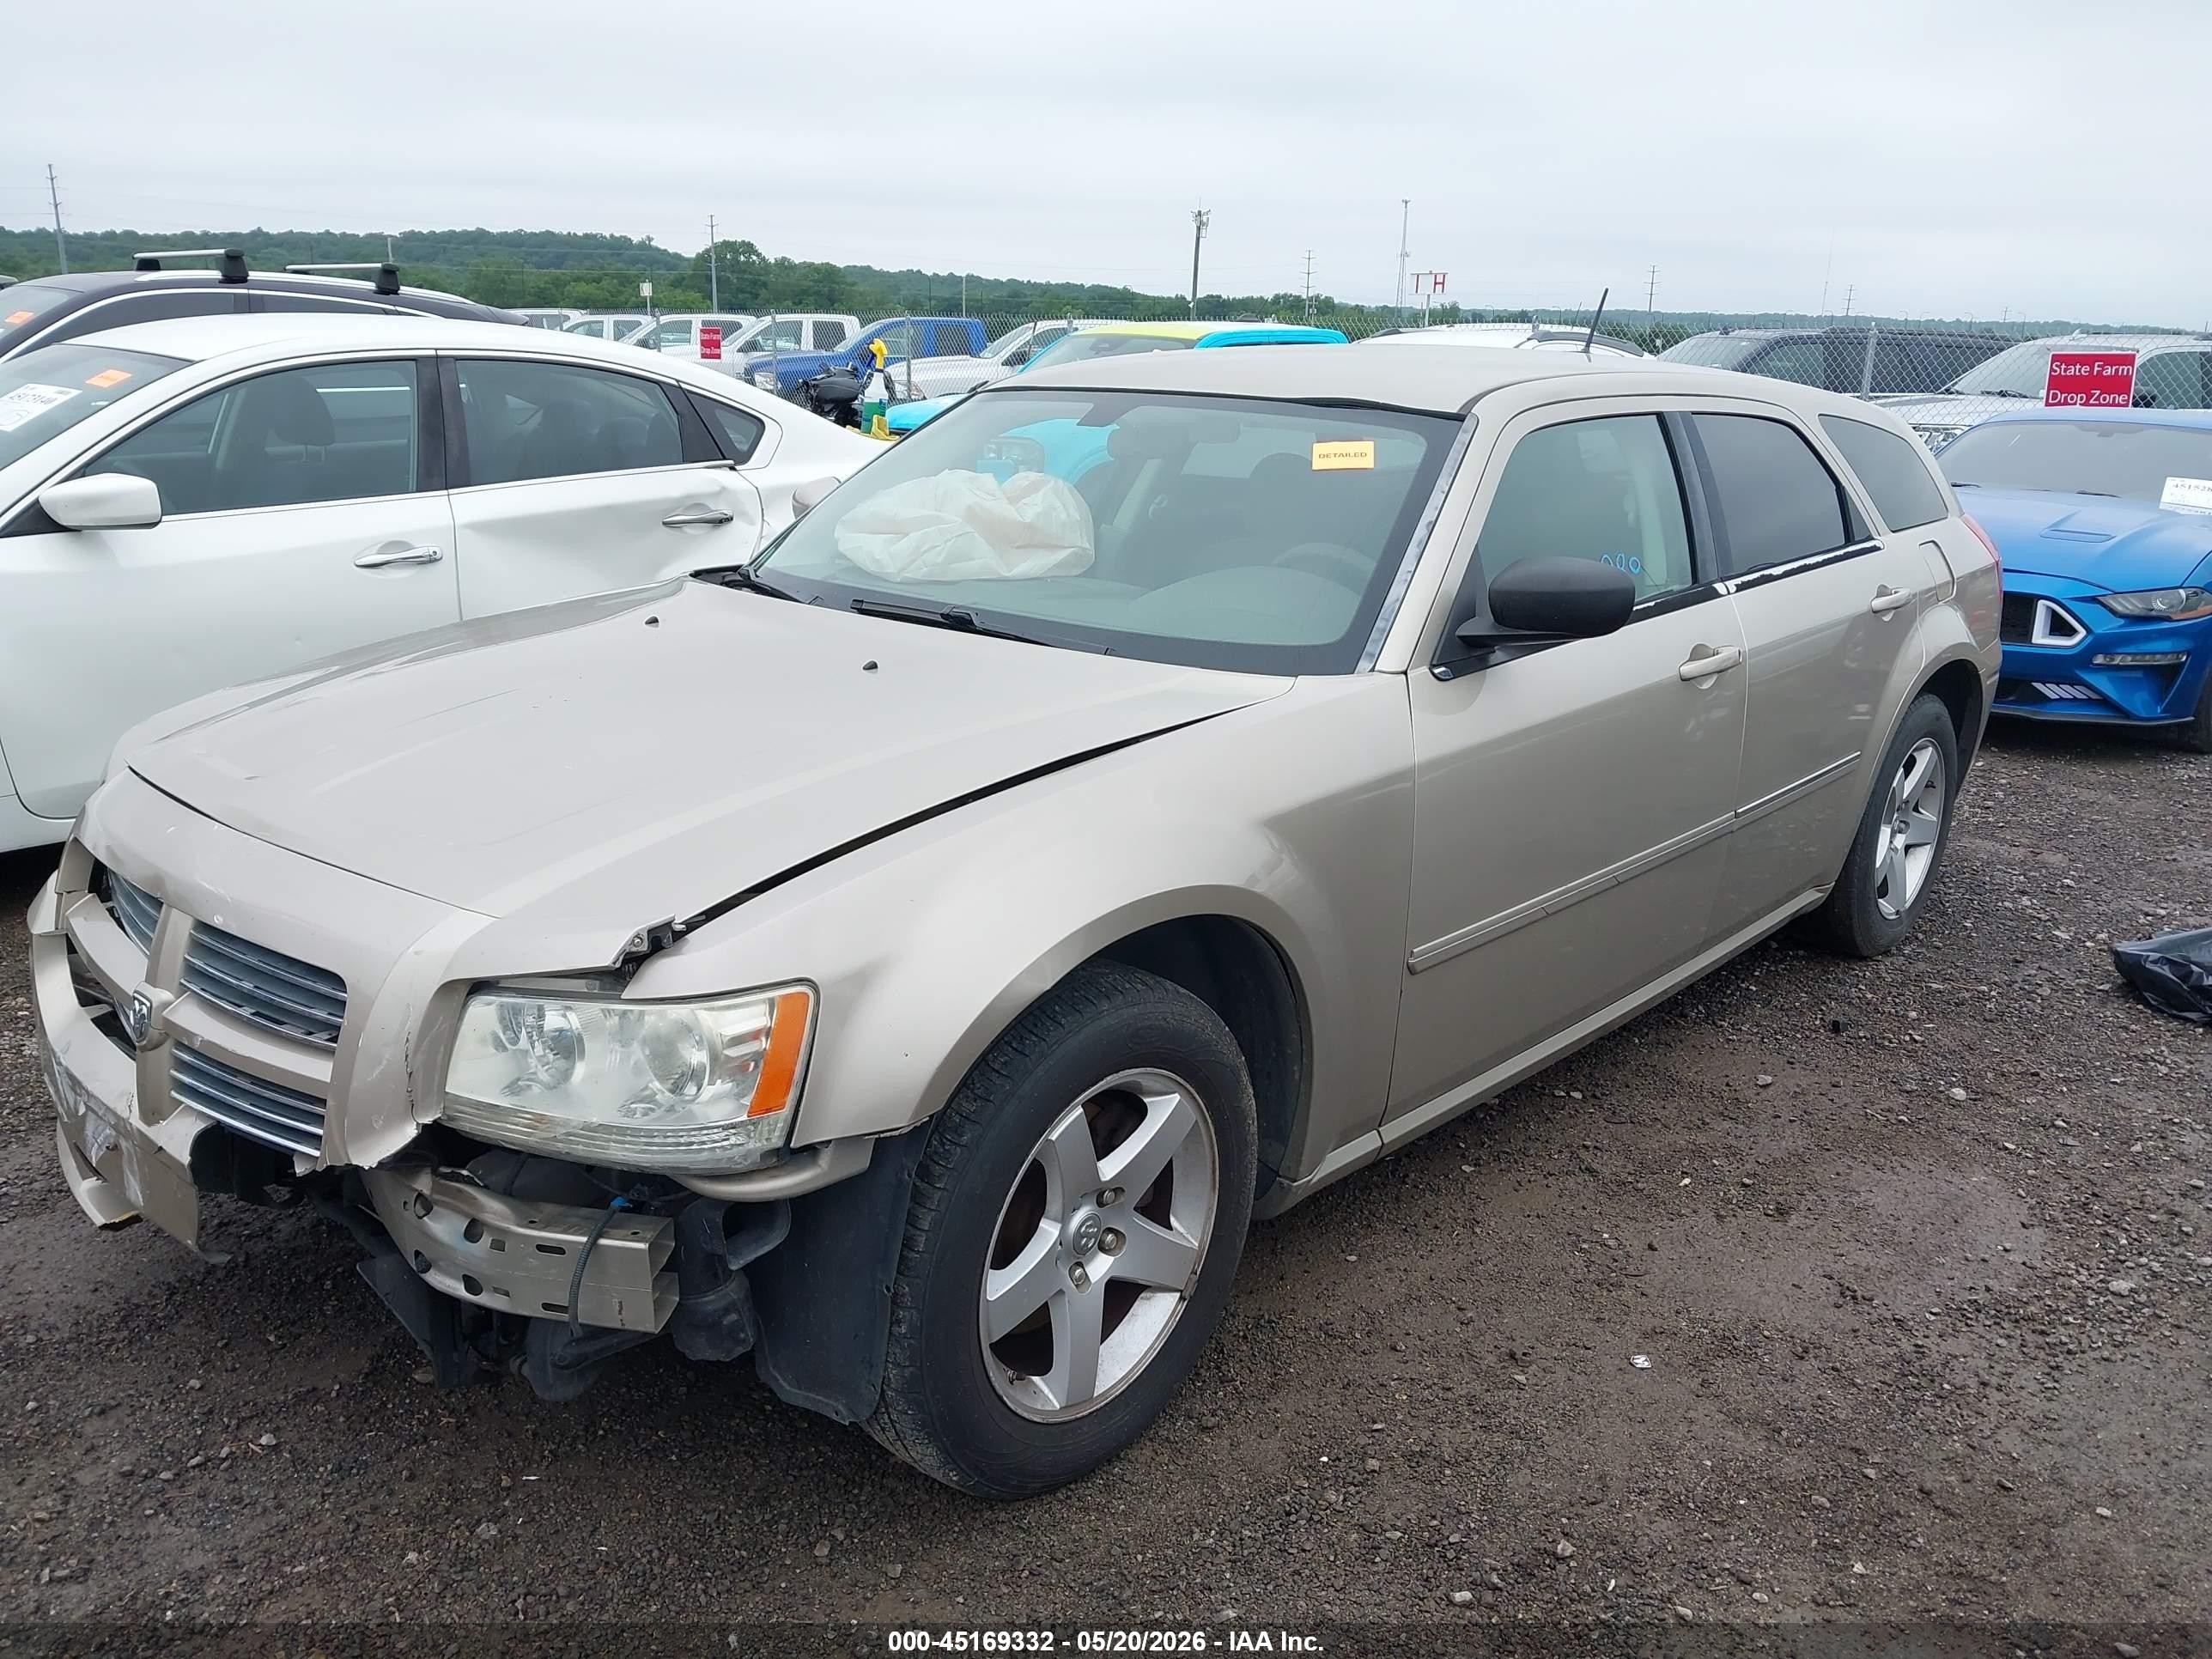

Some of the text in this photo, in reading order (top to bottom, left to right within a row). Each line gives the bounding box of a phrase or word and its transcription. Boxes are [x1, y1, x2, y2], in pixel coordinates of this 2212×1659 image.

[1432, 274, 1446, 294] H
[2051, 362, 2133, 376] State Farm
[2048, 390, 2129, 406] Drop Zone
